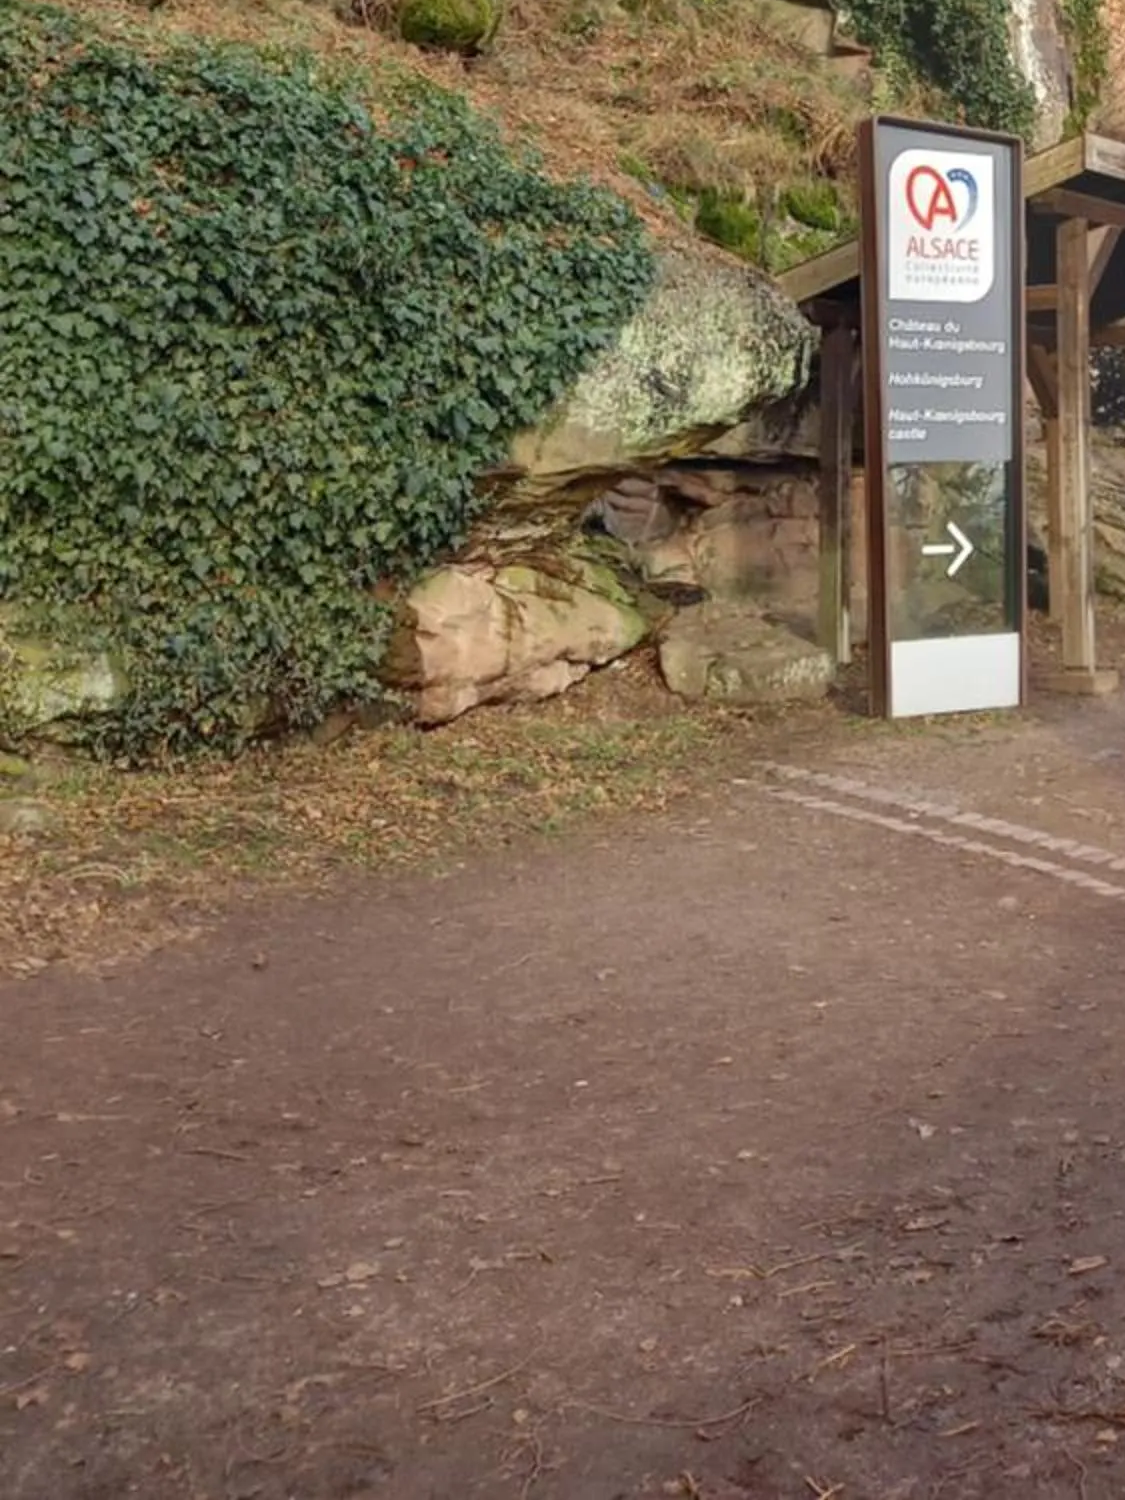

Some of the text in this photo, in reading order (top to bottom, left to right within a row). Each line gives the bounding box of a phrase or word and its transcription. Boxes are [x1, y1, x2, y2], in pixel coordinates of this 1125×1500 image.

[906, 236, 980, 261] ALSACE
[888, 318, 961, 333] Château du
[888, 426, 927, 440] castle
